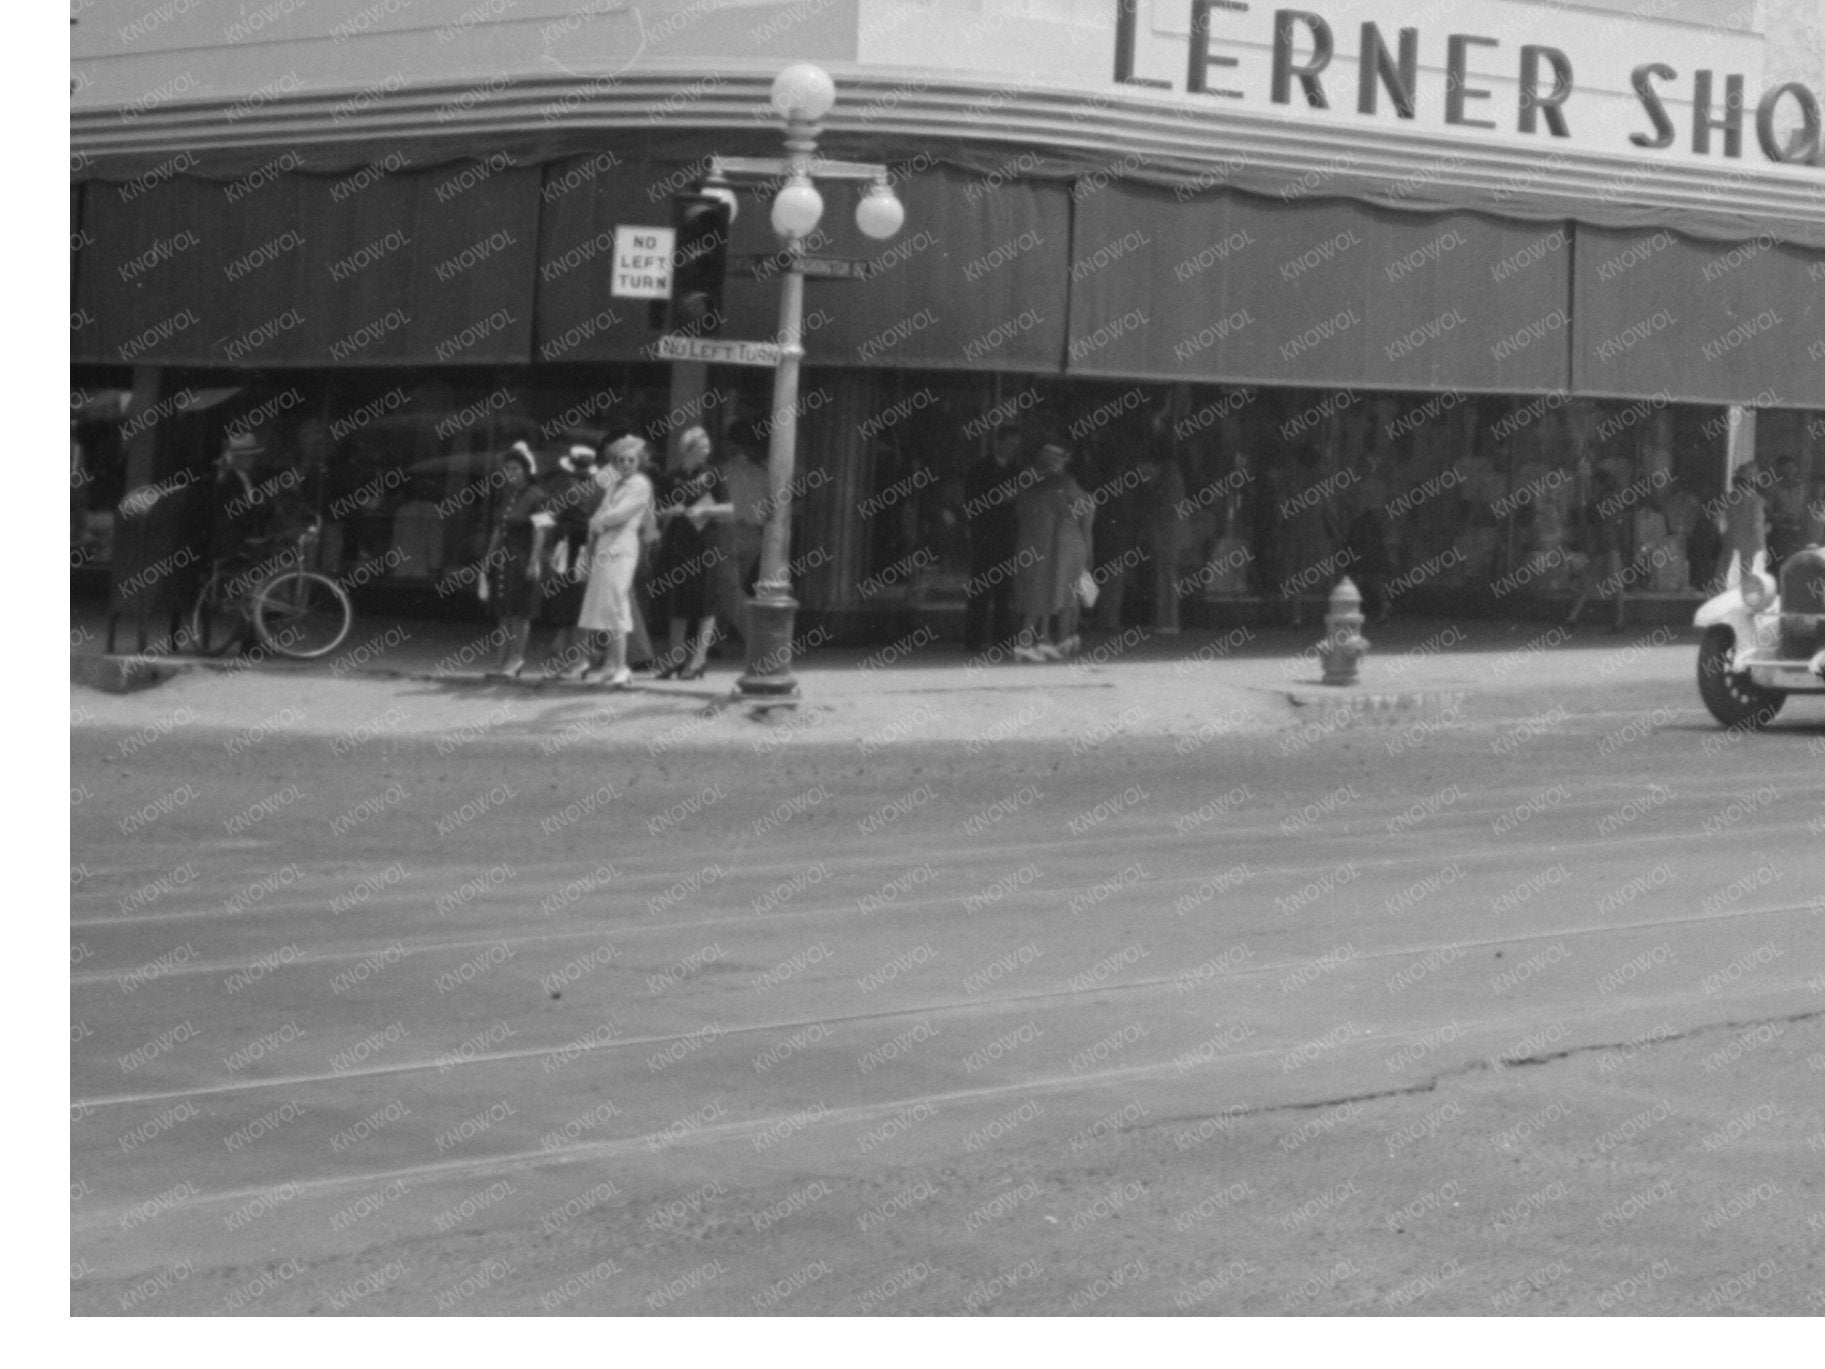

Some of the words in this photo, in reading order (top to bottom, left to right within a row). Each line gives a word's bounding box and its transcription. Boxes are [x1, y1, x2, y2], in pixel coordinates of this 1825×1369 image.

[633, 235, 657, 250] NO
[620, 255, 666, 270] LEFT
[618, 273, 667, 290] TURN
[663, 338, 687, 356] NO
[690, 340, 732, 360] LEFT
[738, 343, 778, 363] TURN
